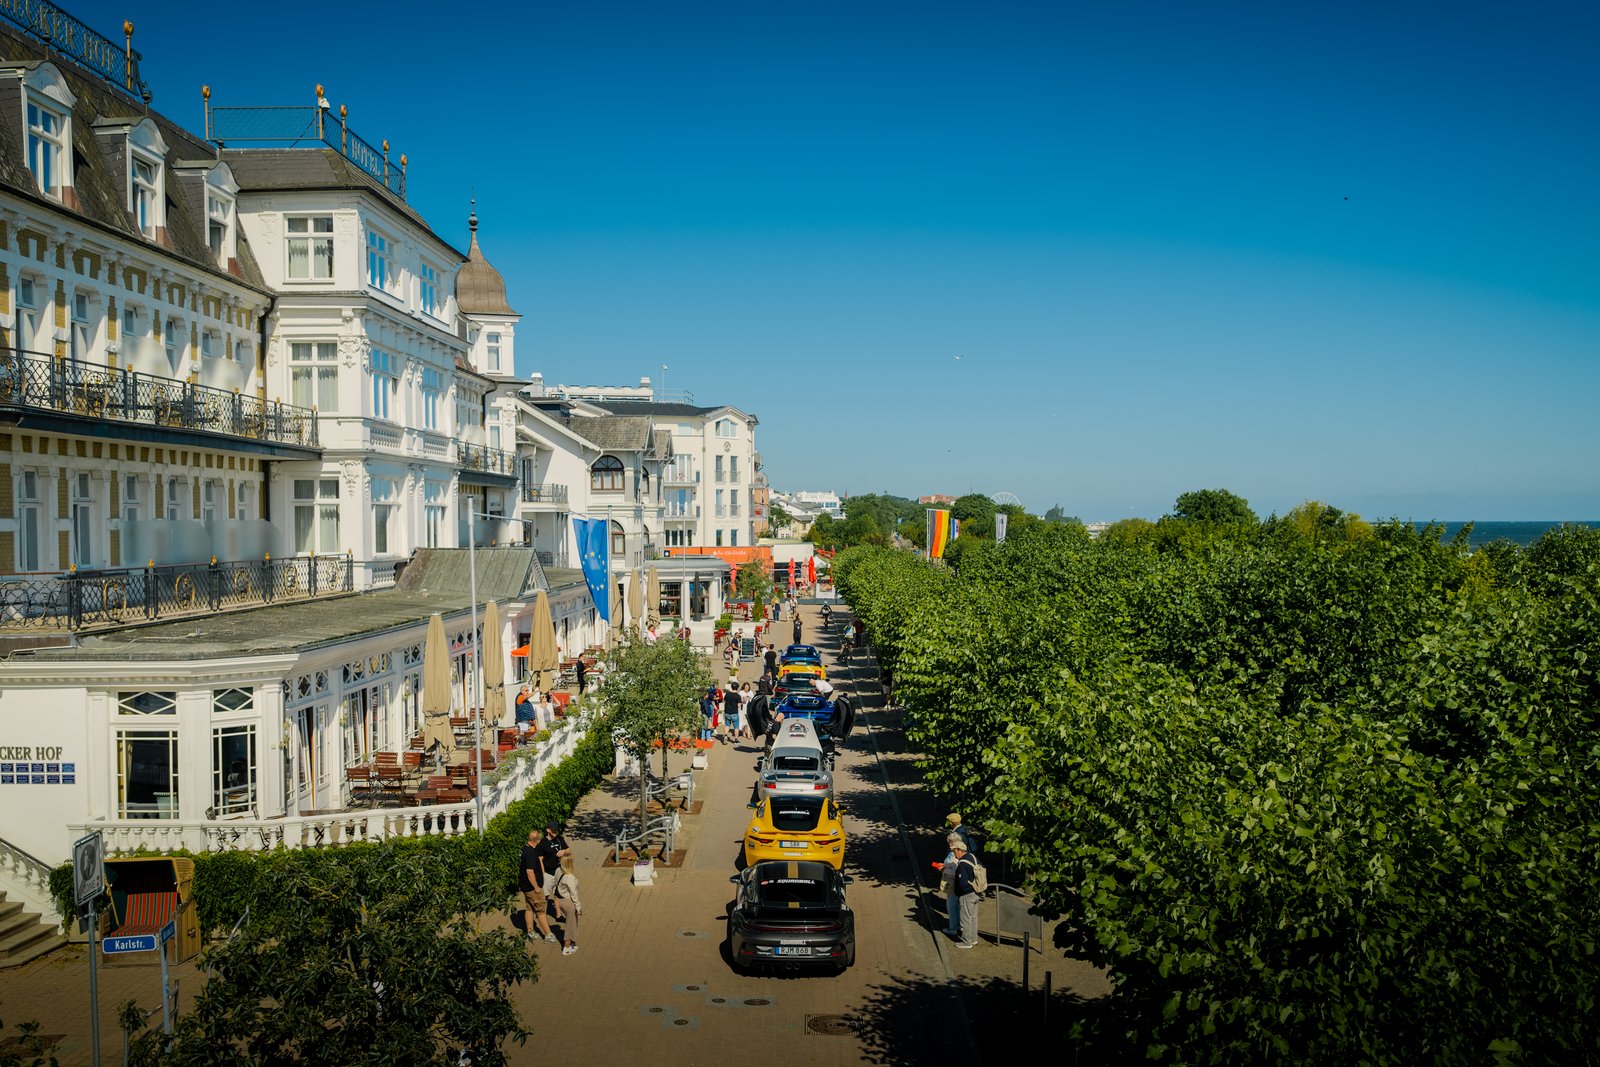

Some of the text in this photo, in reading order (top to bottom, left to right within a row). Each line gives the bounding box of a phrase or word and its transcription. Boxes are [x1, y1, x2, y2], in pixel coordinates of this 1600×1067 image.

[351, 137, 381, 176] HOTEL
[36, 746, 63, 761] HOF
[115, 940, 146, 950] Karlstr.
[780, 946, 795, 954] RJM
